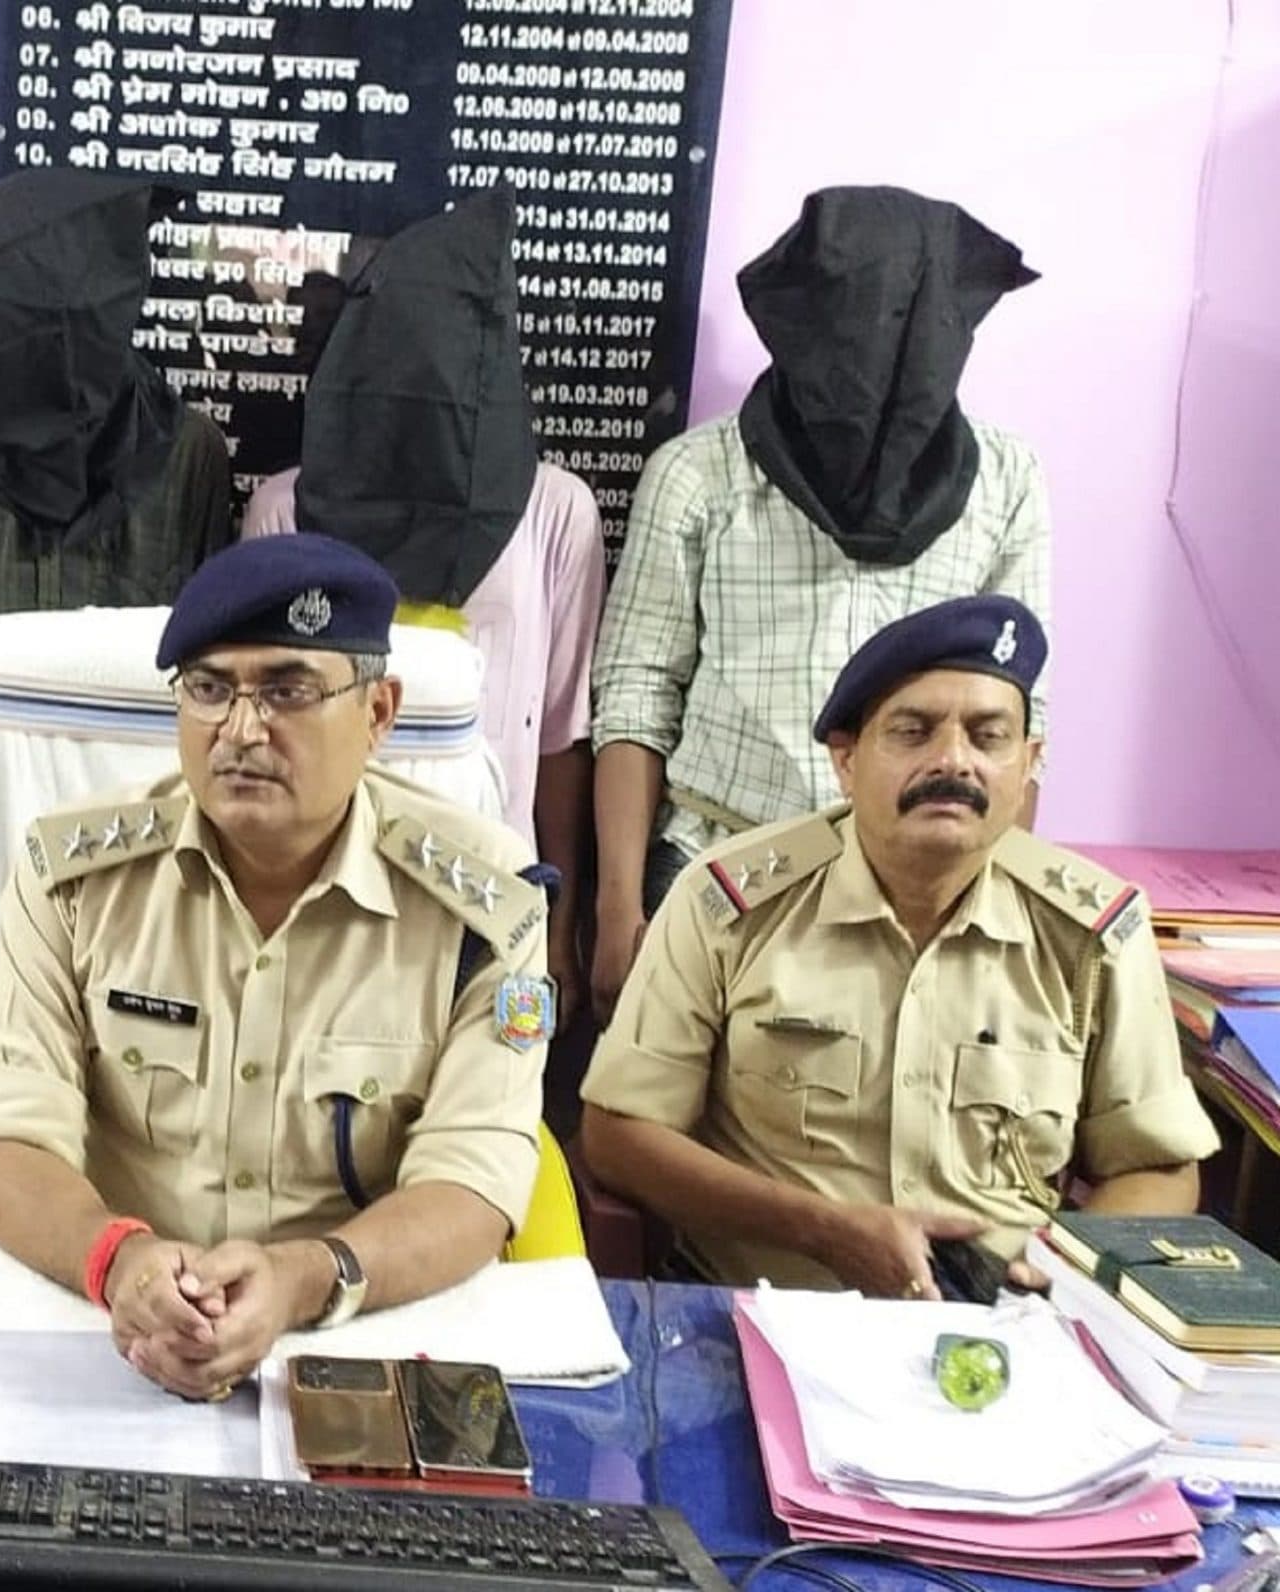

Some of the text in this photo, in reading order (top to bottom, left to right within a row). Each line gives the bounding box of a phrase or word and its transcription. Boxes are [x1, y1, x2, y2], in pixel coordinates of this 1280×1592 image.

[76, 3, 110, 33] श्री
[118, 4, 194, 36] विजय
[200, 14, 276, 46] कुमार
[460, 23, 564, 50] 12.11.2004
[20, 42, 59, 68] 07.
[74, 40, 115, 69] श्री
[272, 54, 360, 81] प्रसाद
[18, 75, 57, 98] 08.
[72, 72, 113, 100] श्री
[121, 75, 173, 106] प्रेम
[181, 77, 270, 109] मोहन
[17, 105, 320, 148] 09. श्री अशोक कुमार
[573, 132, 678, 158] 17.07.2010
[15, 142, 53, 167] 10.
[68, 140, 109, 168] श्री
[232, 149, 296, 180] सिंह
[448, 164, 551, 190] 17.072010
[568, 170, 673, 195] 27.10.2013
[197, 190, 284, 215] सहाय
[566, 206, 670, 233] 31.01.2014
[563, 240, 667, 266] 13.11.2014
[547, 383, 649, 406] 19.03.2018
[543, 416, 646, 438] 23.02.2019
